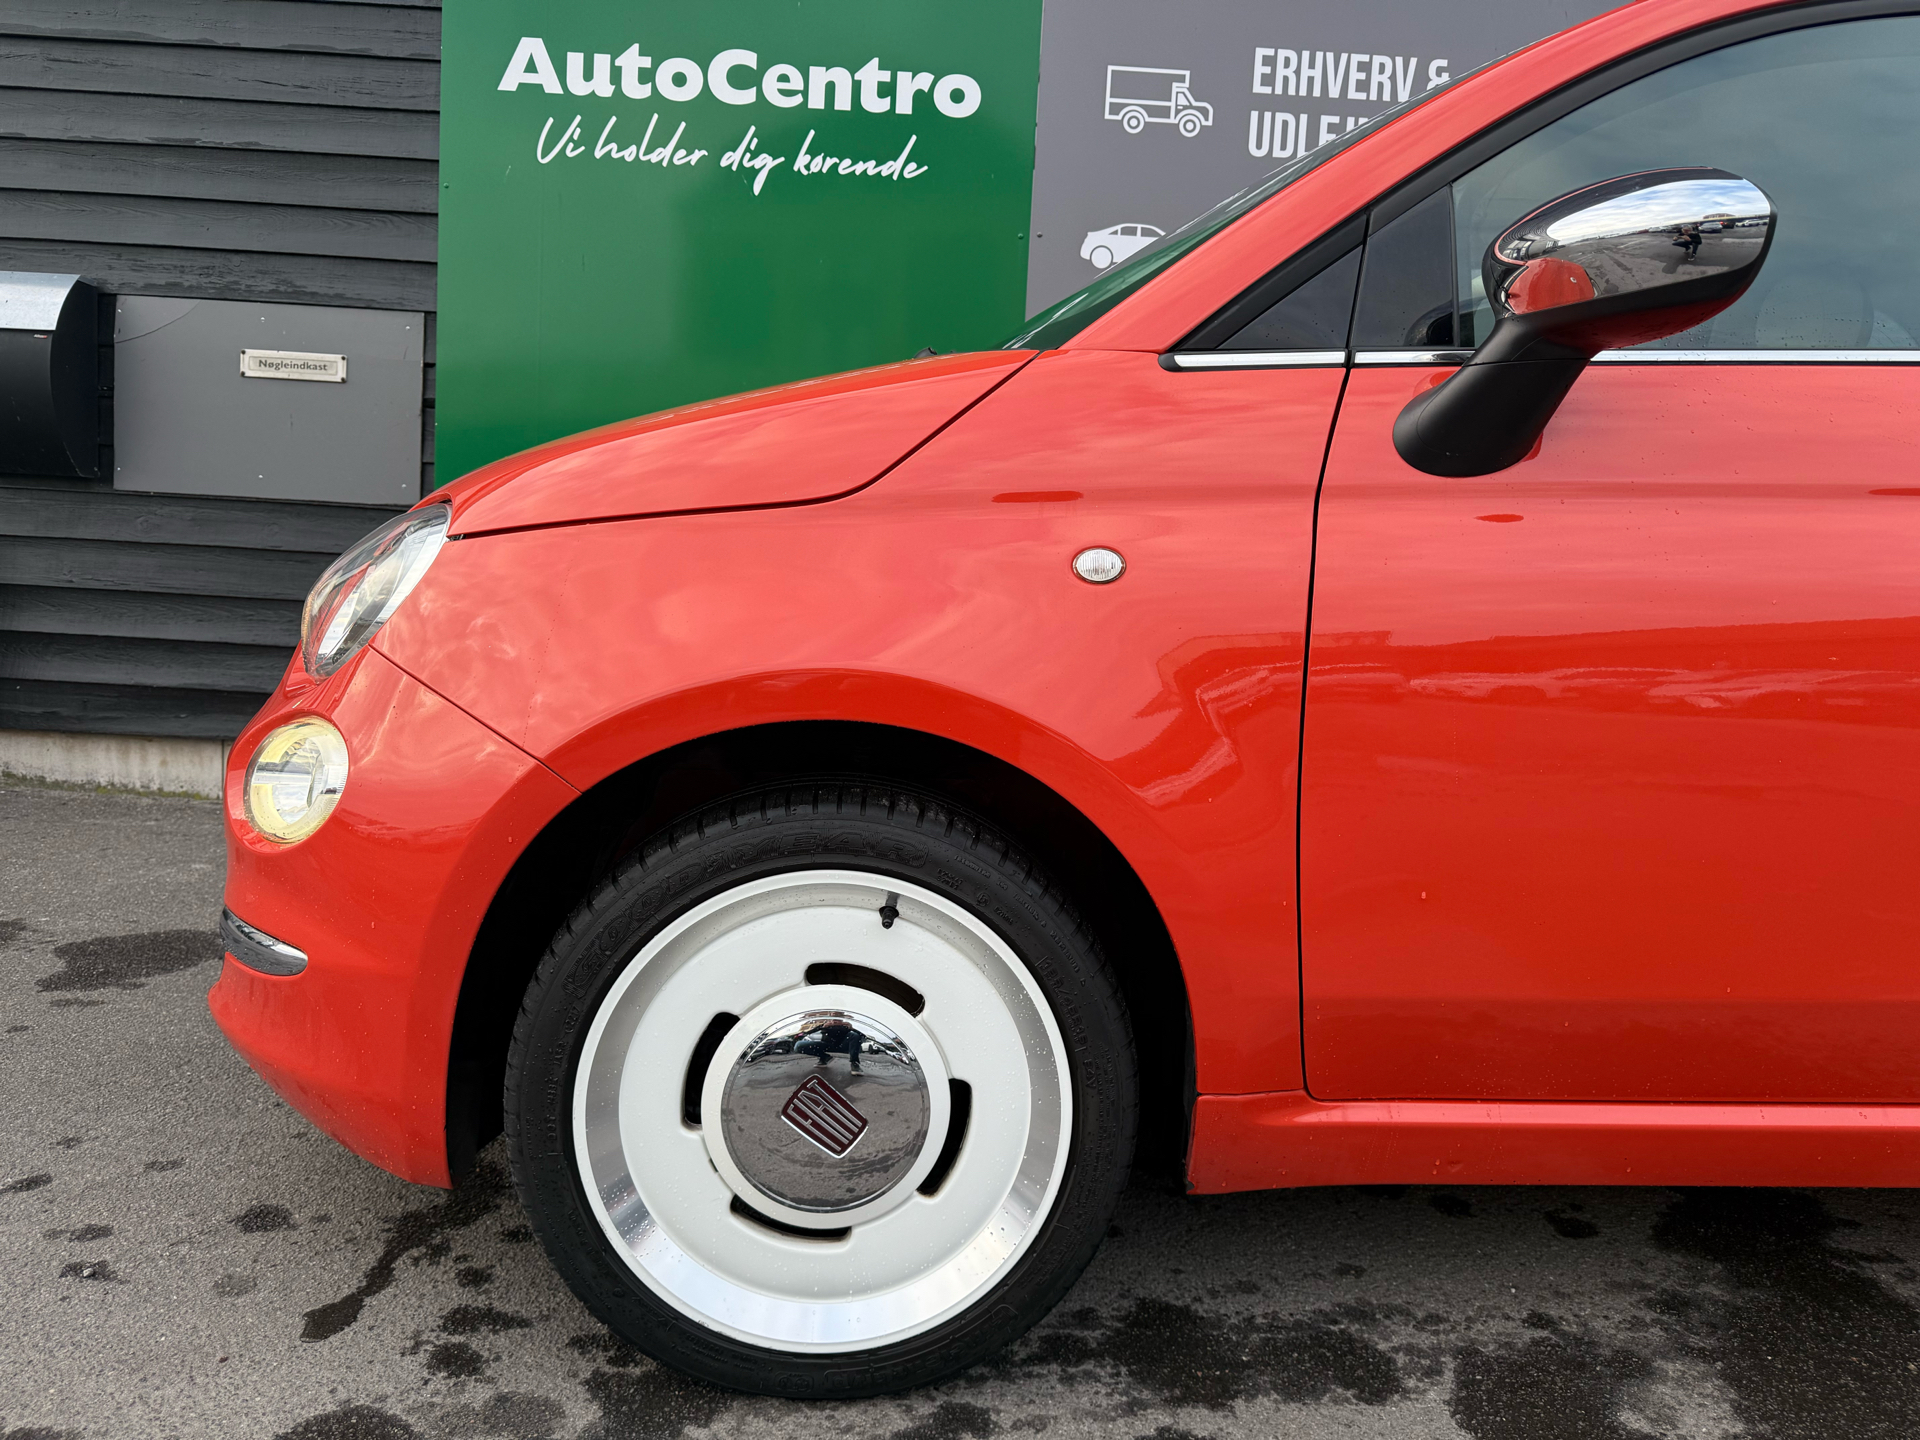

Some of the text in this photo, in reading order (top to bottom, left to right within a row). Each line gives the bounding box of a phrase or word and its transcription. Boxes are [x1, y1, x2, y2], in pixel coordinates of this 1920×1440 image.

[497, 36, 982, 119] AutoCentro
[1252, 47, 1418, 103] ERHVERV
[536, 113, 929, 196] Vi holder dig kørende
[258, 359, 328, 371] Nøgleindkast
[786, 1079, 863, 1152] FIAT
